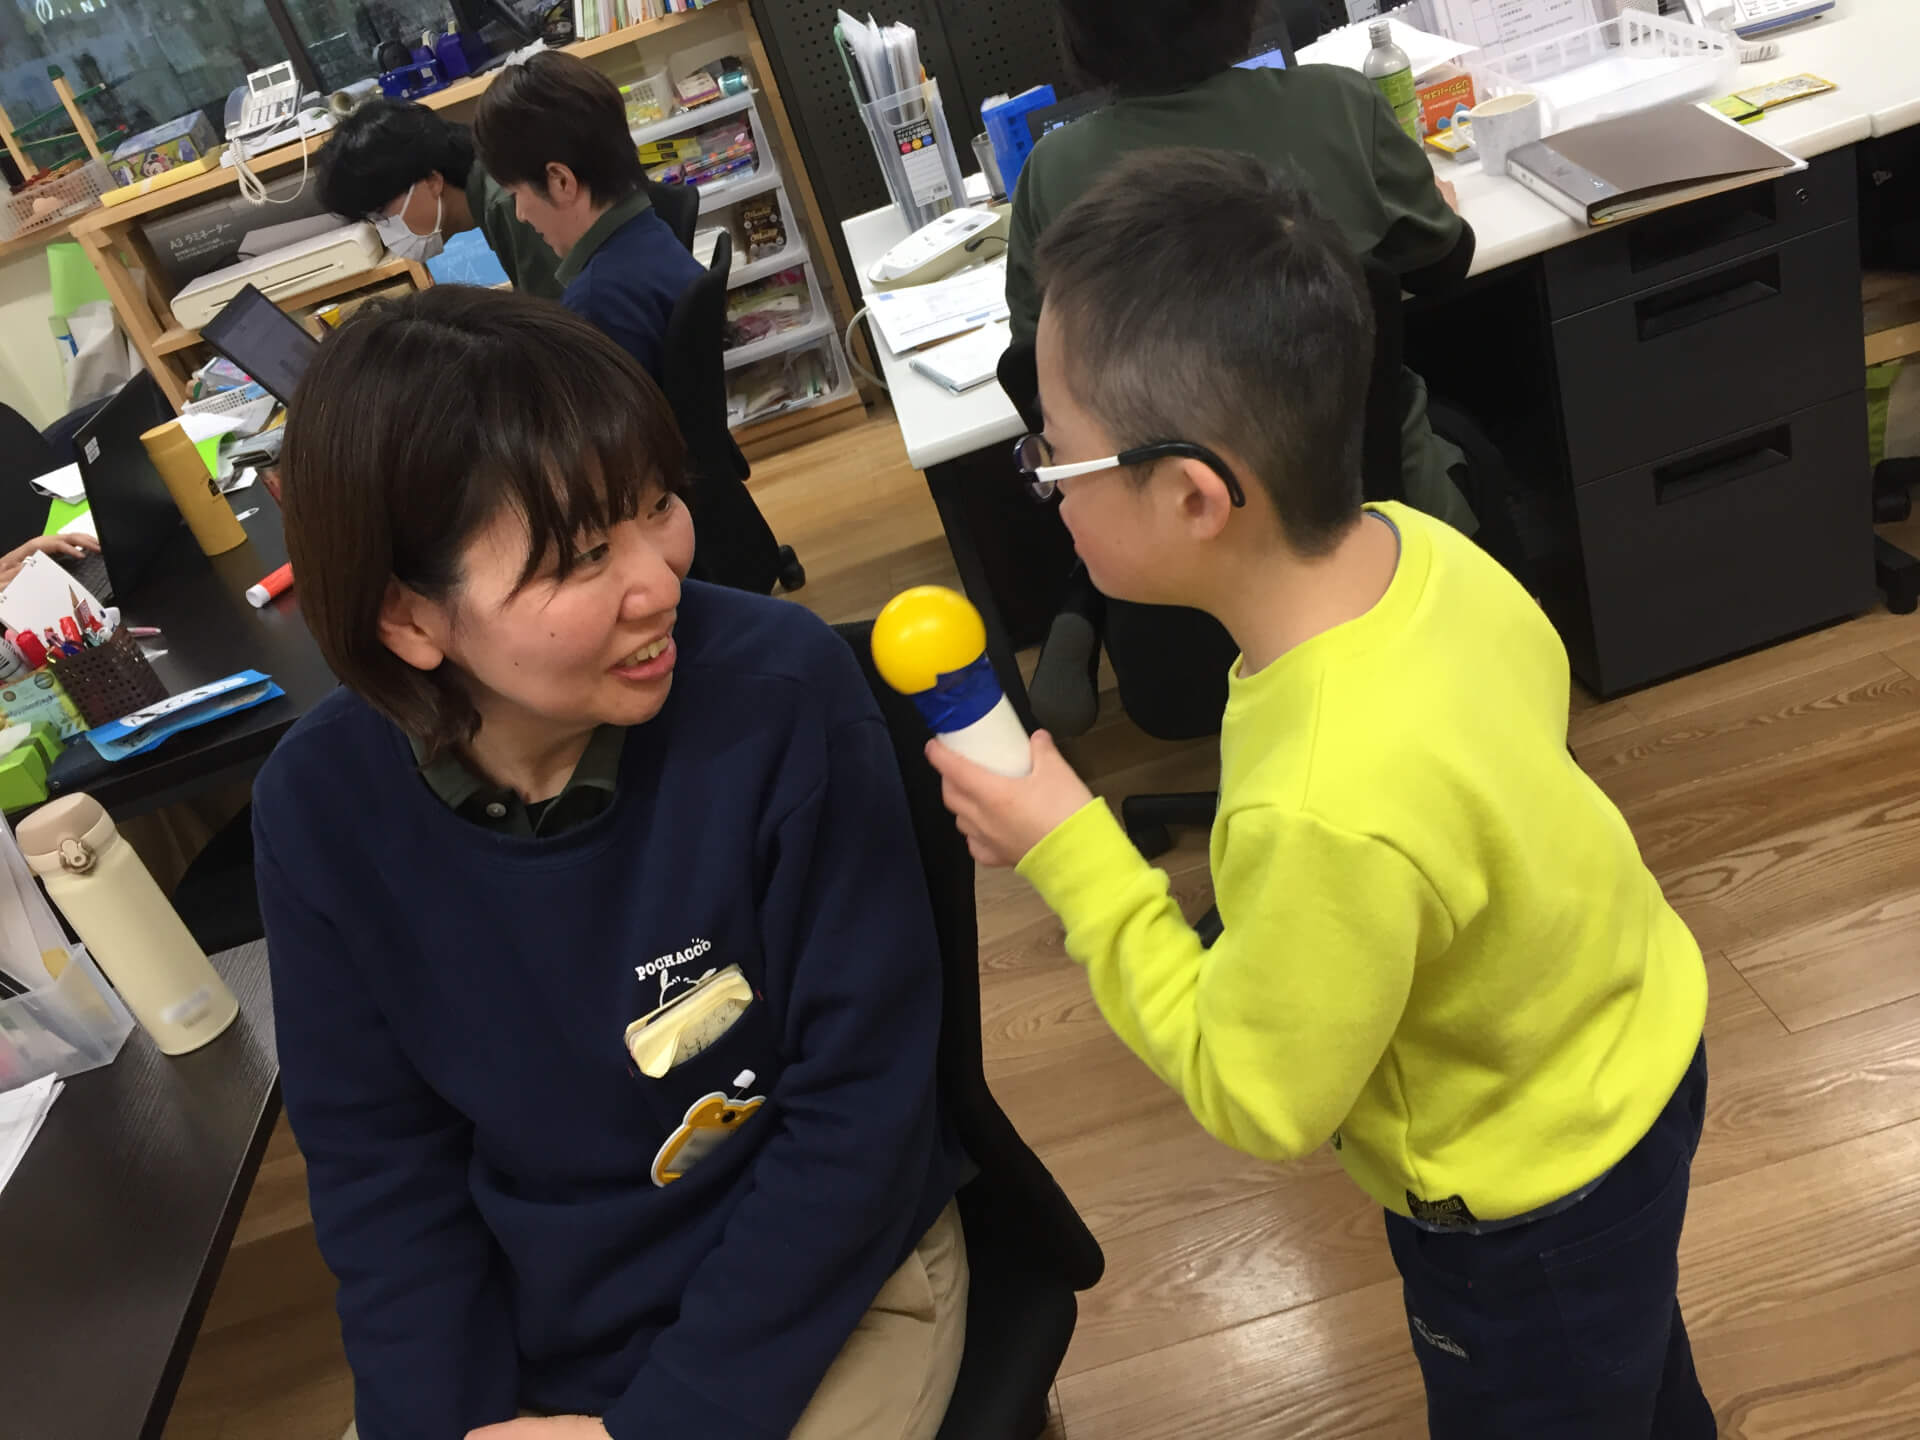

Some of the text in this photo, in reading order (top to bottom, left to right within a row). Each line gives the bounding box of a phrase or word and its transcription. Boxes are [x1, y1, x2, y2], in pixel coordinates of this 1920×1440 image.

[169, 237, 184, 251] A3
[185, 223, 232, 244] ラミネーター
[635, 939, 712, 981] POCHACCO
